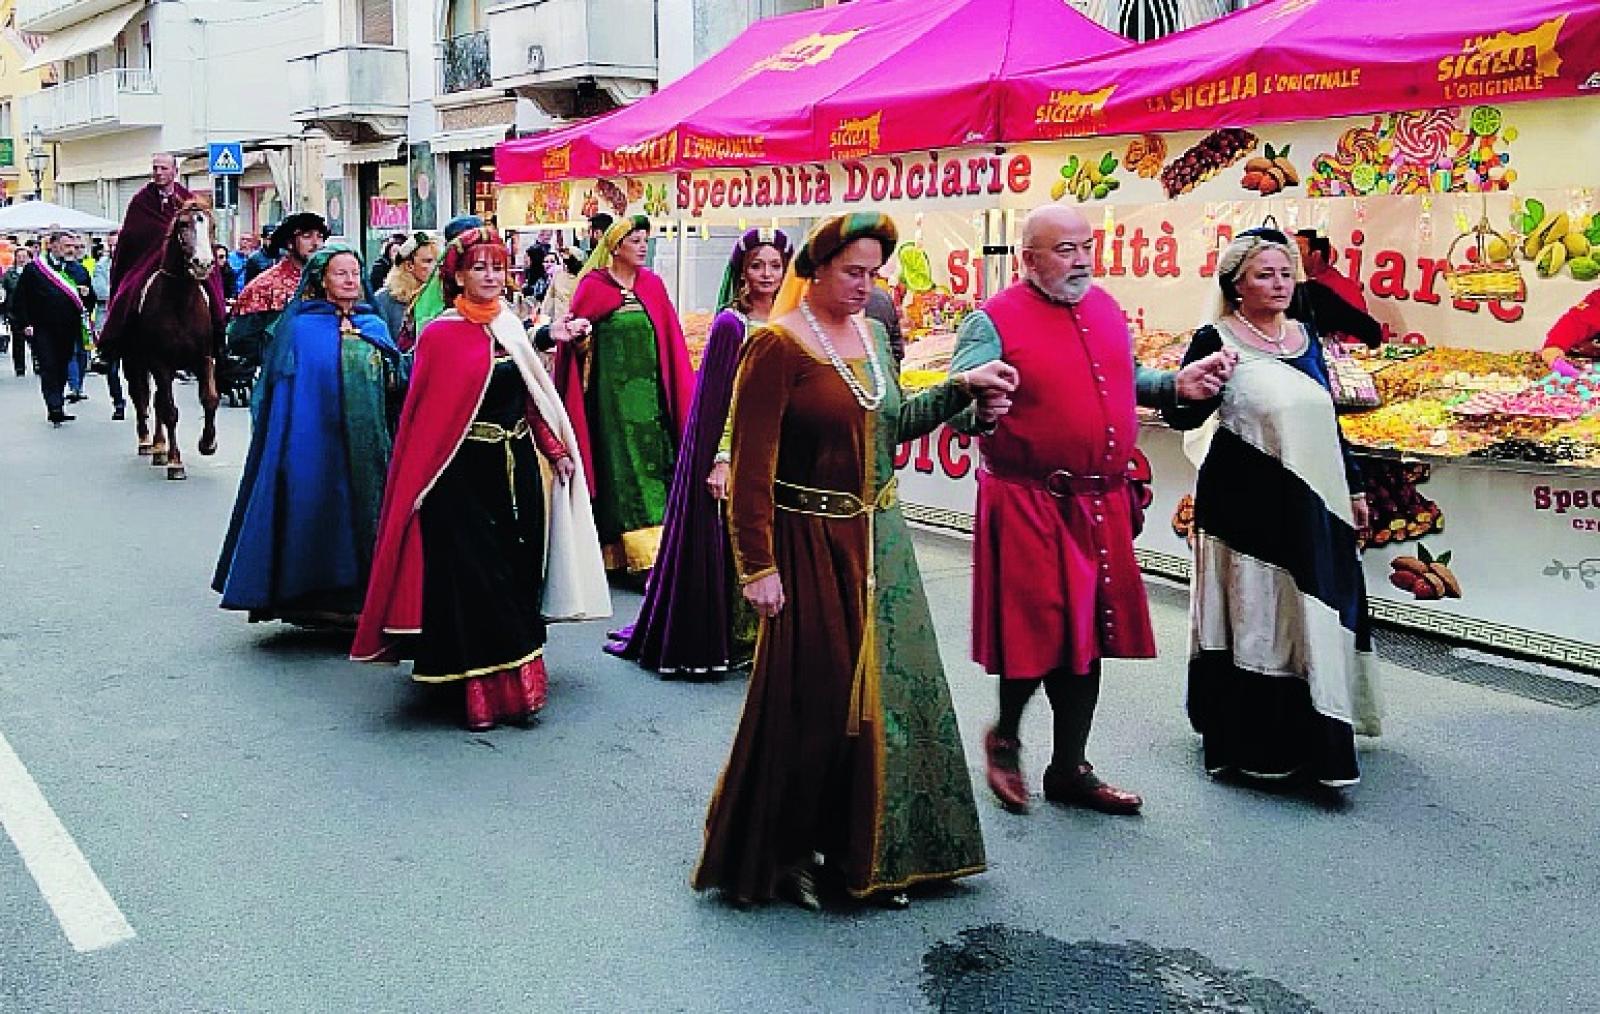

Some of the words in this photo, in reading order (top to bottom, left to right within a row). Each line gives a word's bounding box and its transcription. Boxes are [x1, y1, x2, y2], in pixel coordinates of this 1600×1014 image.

[1146, 96, 1166, 112] LA
[1170, 72, 1258, 113] SICILIA
[1263, 68, 1361, 94] L'ORIGINALE
[1443, 72, 1544, 100] L'ORIGINALE
